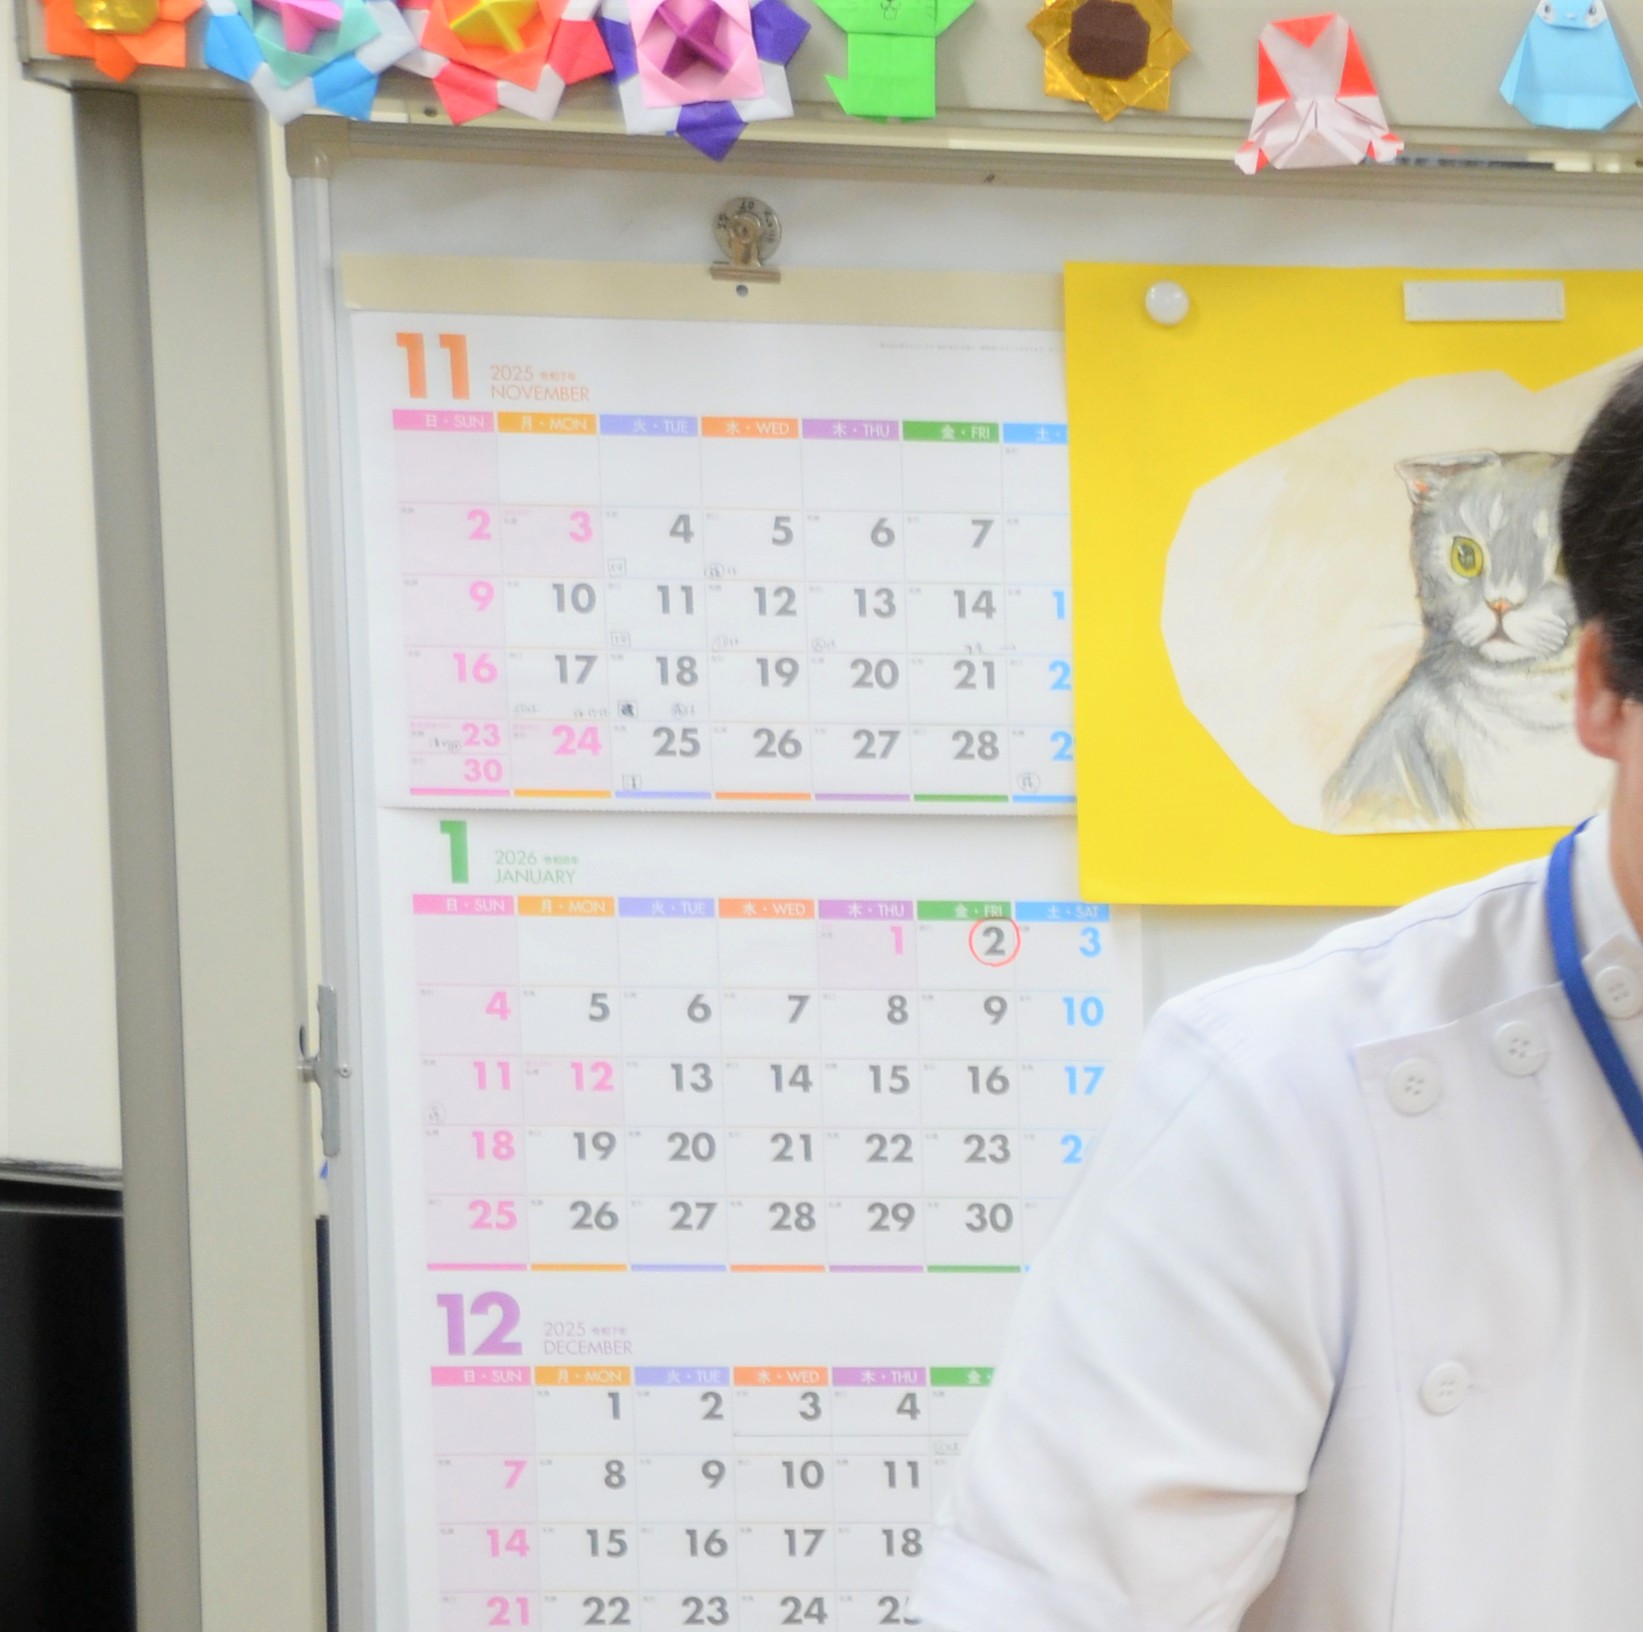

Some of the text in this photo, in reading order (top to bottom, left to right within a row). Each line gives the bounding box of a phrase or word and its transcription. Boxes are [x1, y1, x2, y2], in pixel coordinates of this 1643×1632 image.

[396, 331, 468, 398] 11
[490, 364, 533, 381] 2025
[491, 384, 589, 401] NOVEMBER
[467, 509, 993, 548] 2 3 4 5 6 7
[469, 580, 996, 618] 9 10 11 12 13 14
[453, 652, 994, 689] 16 17 18 19 20 21
[462, 722, 500, 747] 23
[552, 724, 602, 755] 24
[653, 726, 700, 757] 25
[753, 728, 802, 758] 26
[853, 729, 900, 758] 27
[952, 729, 999, 761] 28
[464, 758, 503, 783] 30
[440, 819, 468, 883] 1
[496, 850, 537, 865] 2026
[496, 869, 574, 884] JANUARY
[890, 926, 1101, 957] 1 2 3
[485, 991, 1104, 1027] 4 5 6 7 8 9 10
[473, 1061, 1104, 1095] 11 12 13 14 15 16 17
[472, 1130, 1010, 1164] 18 19 20 21 22 23
[469, 1200, 1013, 1232] 25 26 27 28 29 30
[437, 1291, 522, 1355] 12
[545, 1322, 585, 1336] 2025
[544, 1340, 631, 1355] DECEMBER
[608, 1391, 920, 1421] 1 2 3 4
[504, 1460, 919, 1489] 7 8 9 10 11
[487, 1528, 922, 1557] 14 15 16 17 18
[487, 1596, 529, 1626] 21
[583, 1596, 630, 1625] 22
[682, 1596, 729, 1626] 23
[780, 1596, 827, 1624] 24
